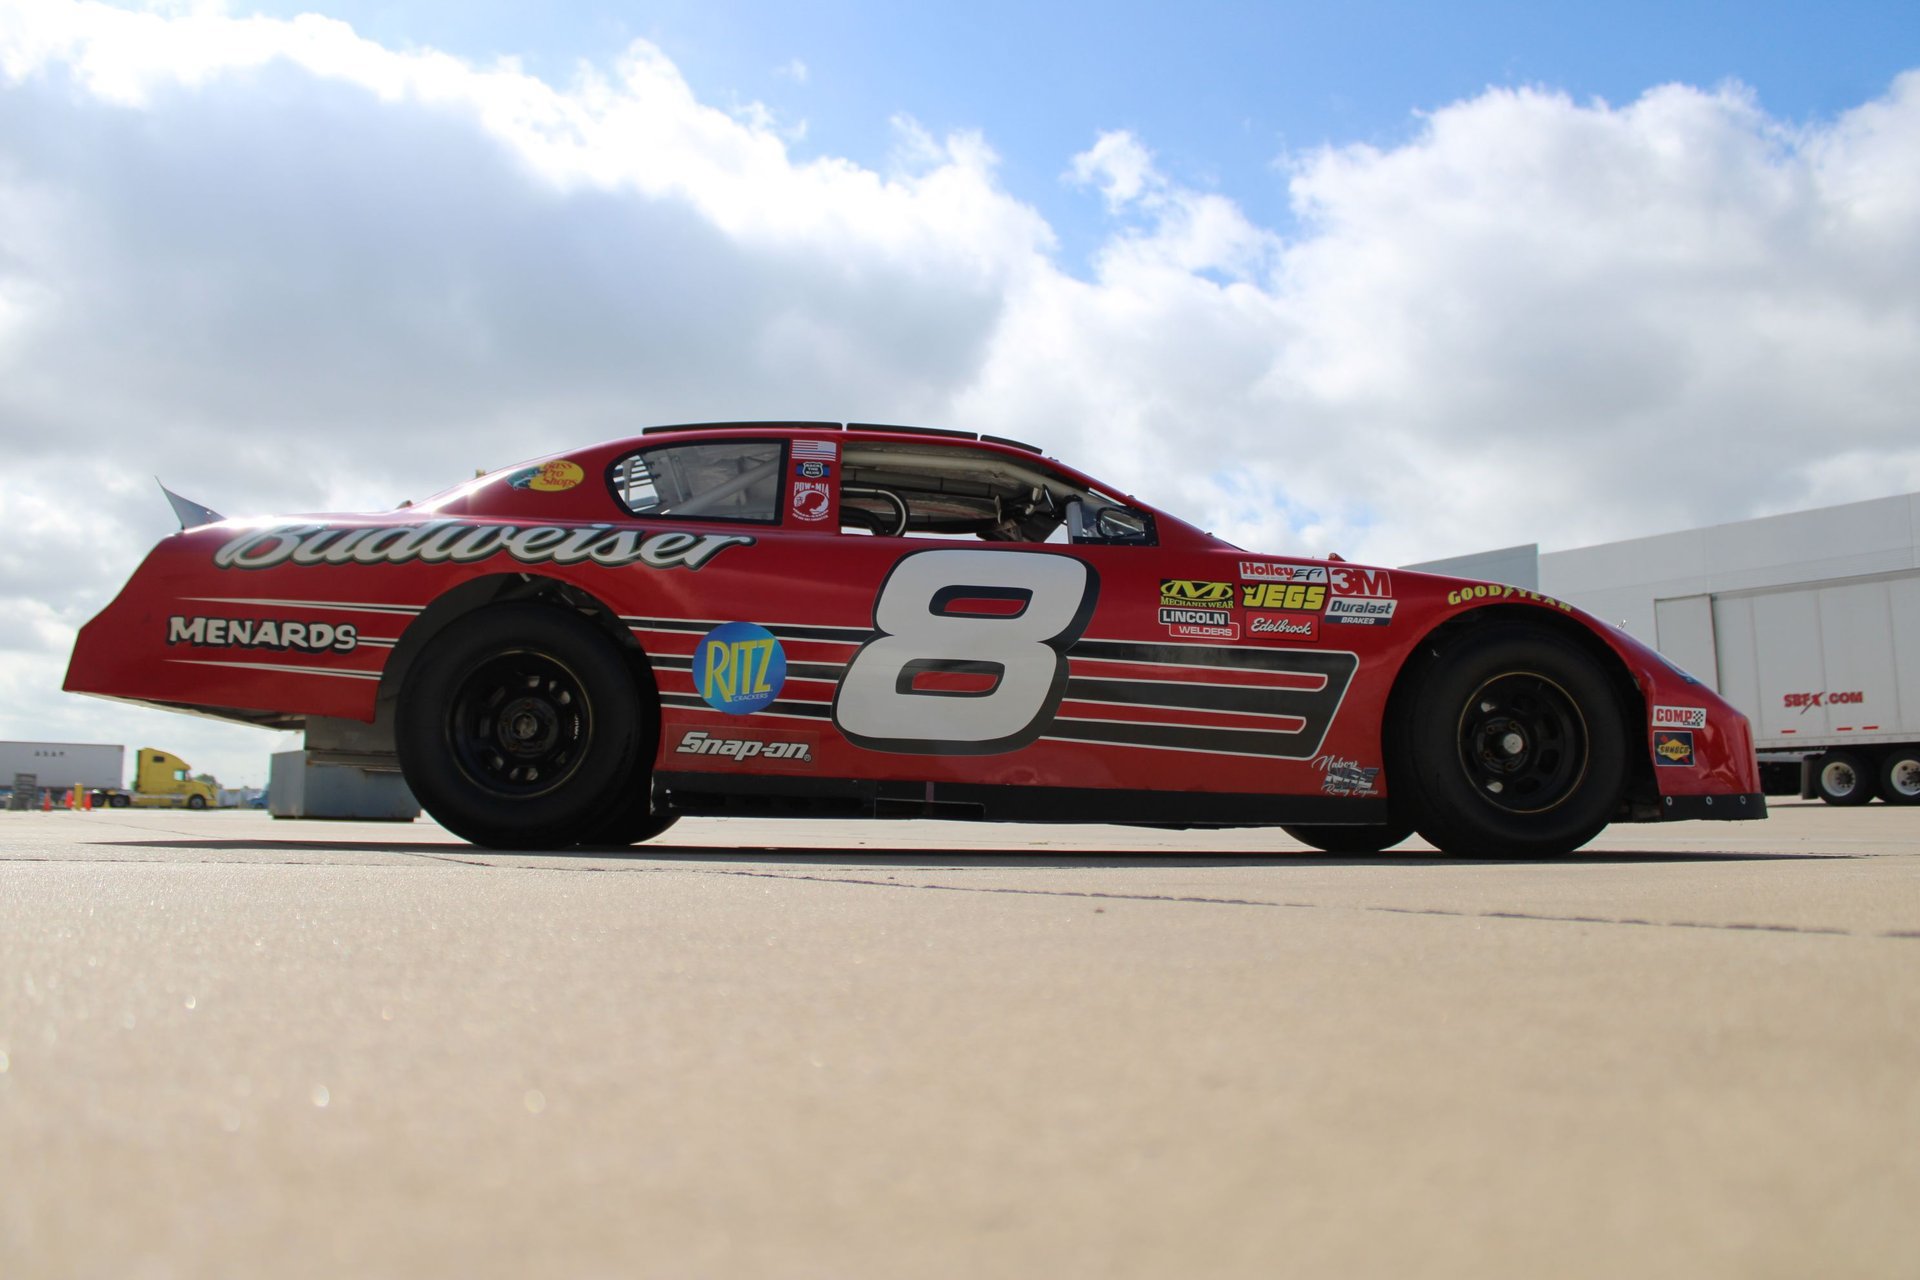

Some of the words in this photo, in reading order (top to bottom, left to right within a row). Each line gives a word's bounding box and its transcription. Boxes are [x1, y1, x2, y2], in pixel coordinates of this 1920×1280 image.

[214, 518, 757, 570] Budweiser
[1242, 563, 1294, 581] Holley
[1293, 568, 1324, 581] EFI
[1331, 568, 1390, 596] 3M
[1161, 596, 1207, 608] MECHANIX
[1208, 600, 1235, 609] WEAR
[1242, 583, 1327, 610] JEGS
[1330, 600, 1392, 615] Duralast
[1162, 610, 1225, 625] LINCOLN
[1250, 617, 1312, 635] Edelbrock
[1341, 616, 1375, 625] BRAKES
[167, 614, 358, 653] MENARDS
[1178, 625, 1233, 637] WELDERS
[833, 547, 1100, 755] 8
[703, 638, 775, 703] RITZ
[733, 692, 769, 702] CRACKERS
[1656, 708, 1692, 723] COMP
